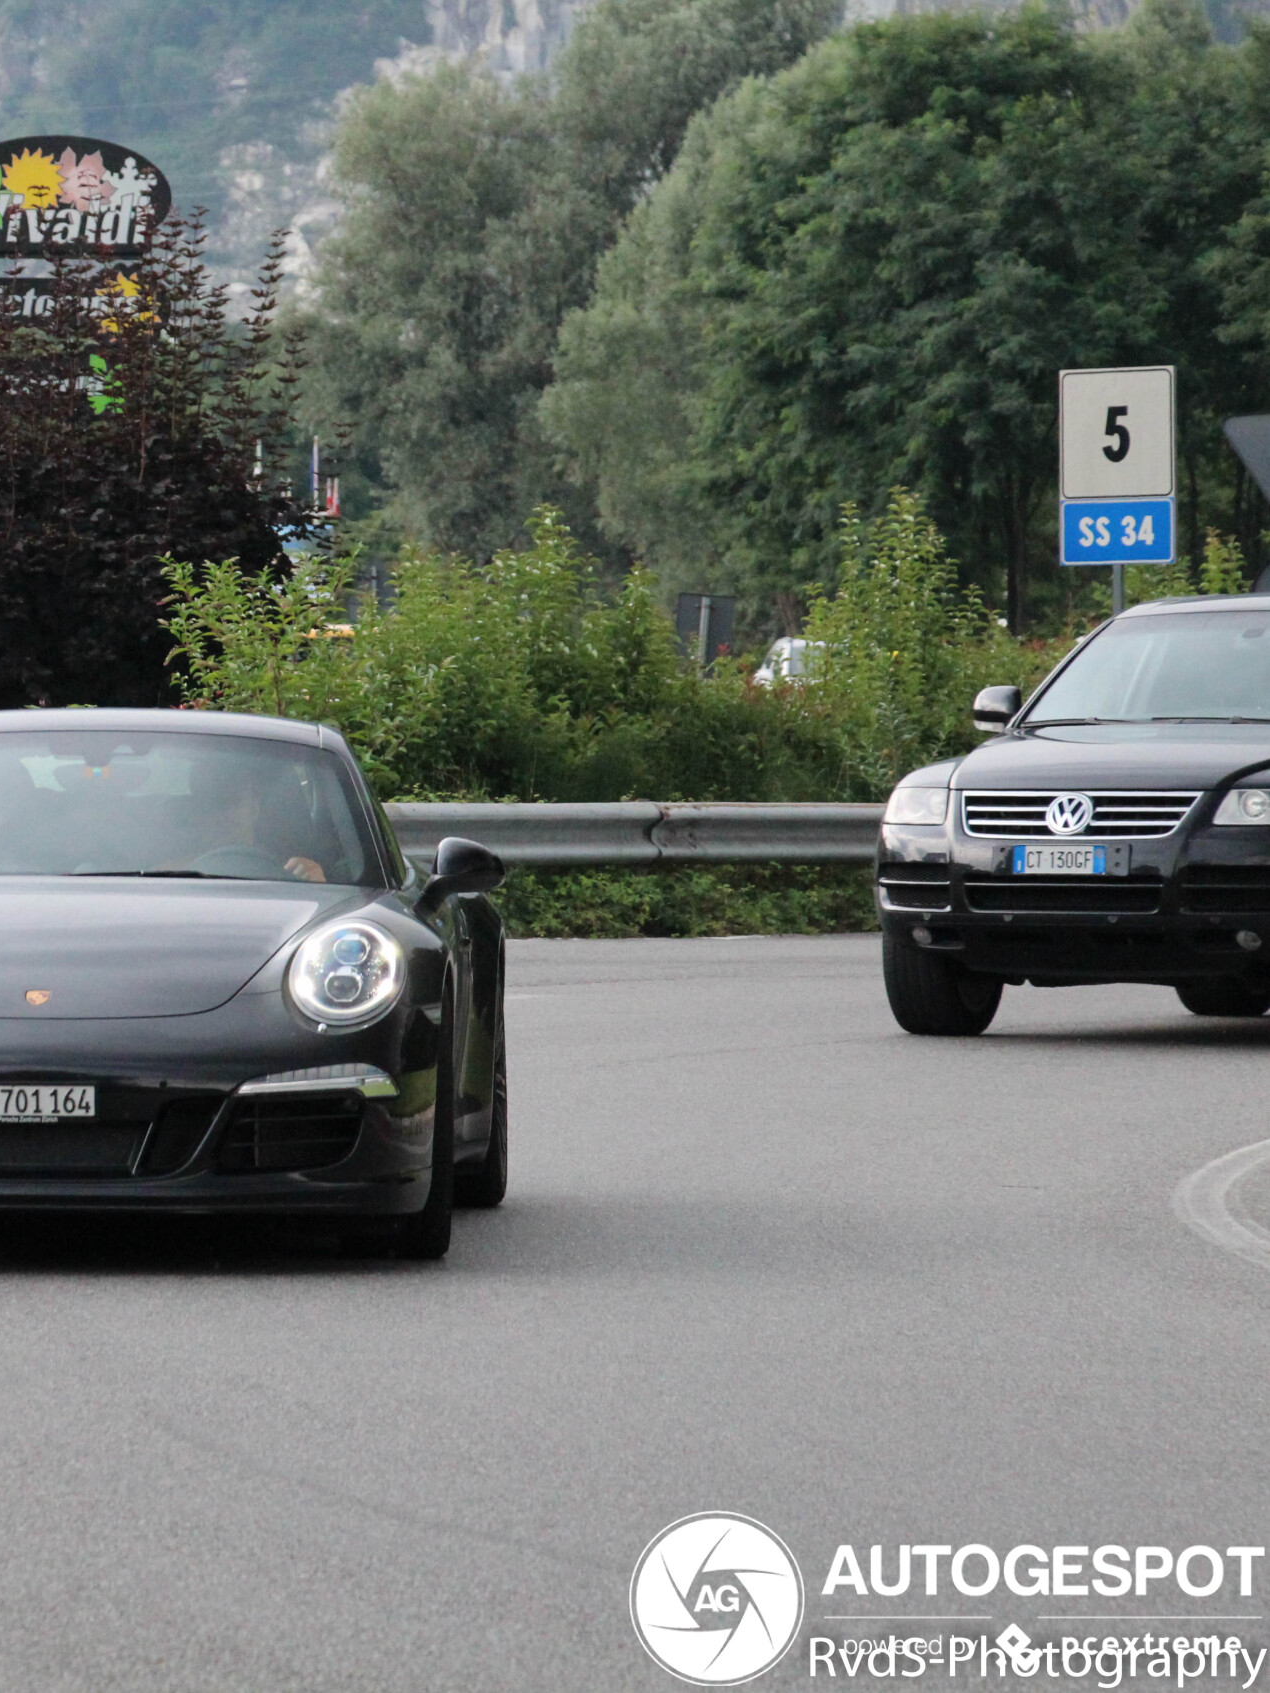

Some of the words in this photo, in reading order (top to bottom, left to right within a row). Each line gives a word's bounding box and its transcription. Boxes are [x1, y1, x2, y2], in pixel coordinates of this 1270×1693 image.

[1102, 405, 1130, 463] 5
[1079, 516, 1111, 547] SS
[1121, 515, 1155, 546] 34
[1027, 851, 1043, 868] CT
[1050, 851, 1092, 869] 130GF
